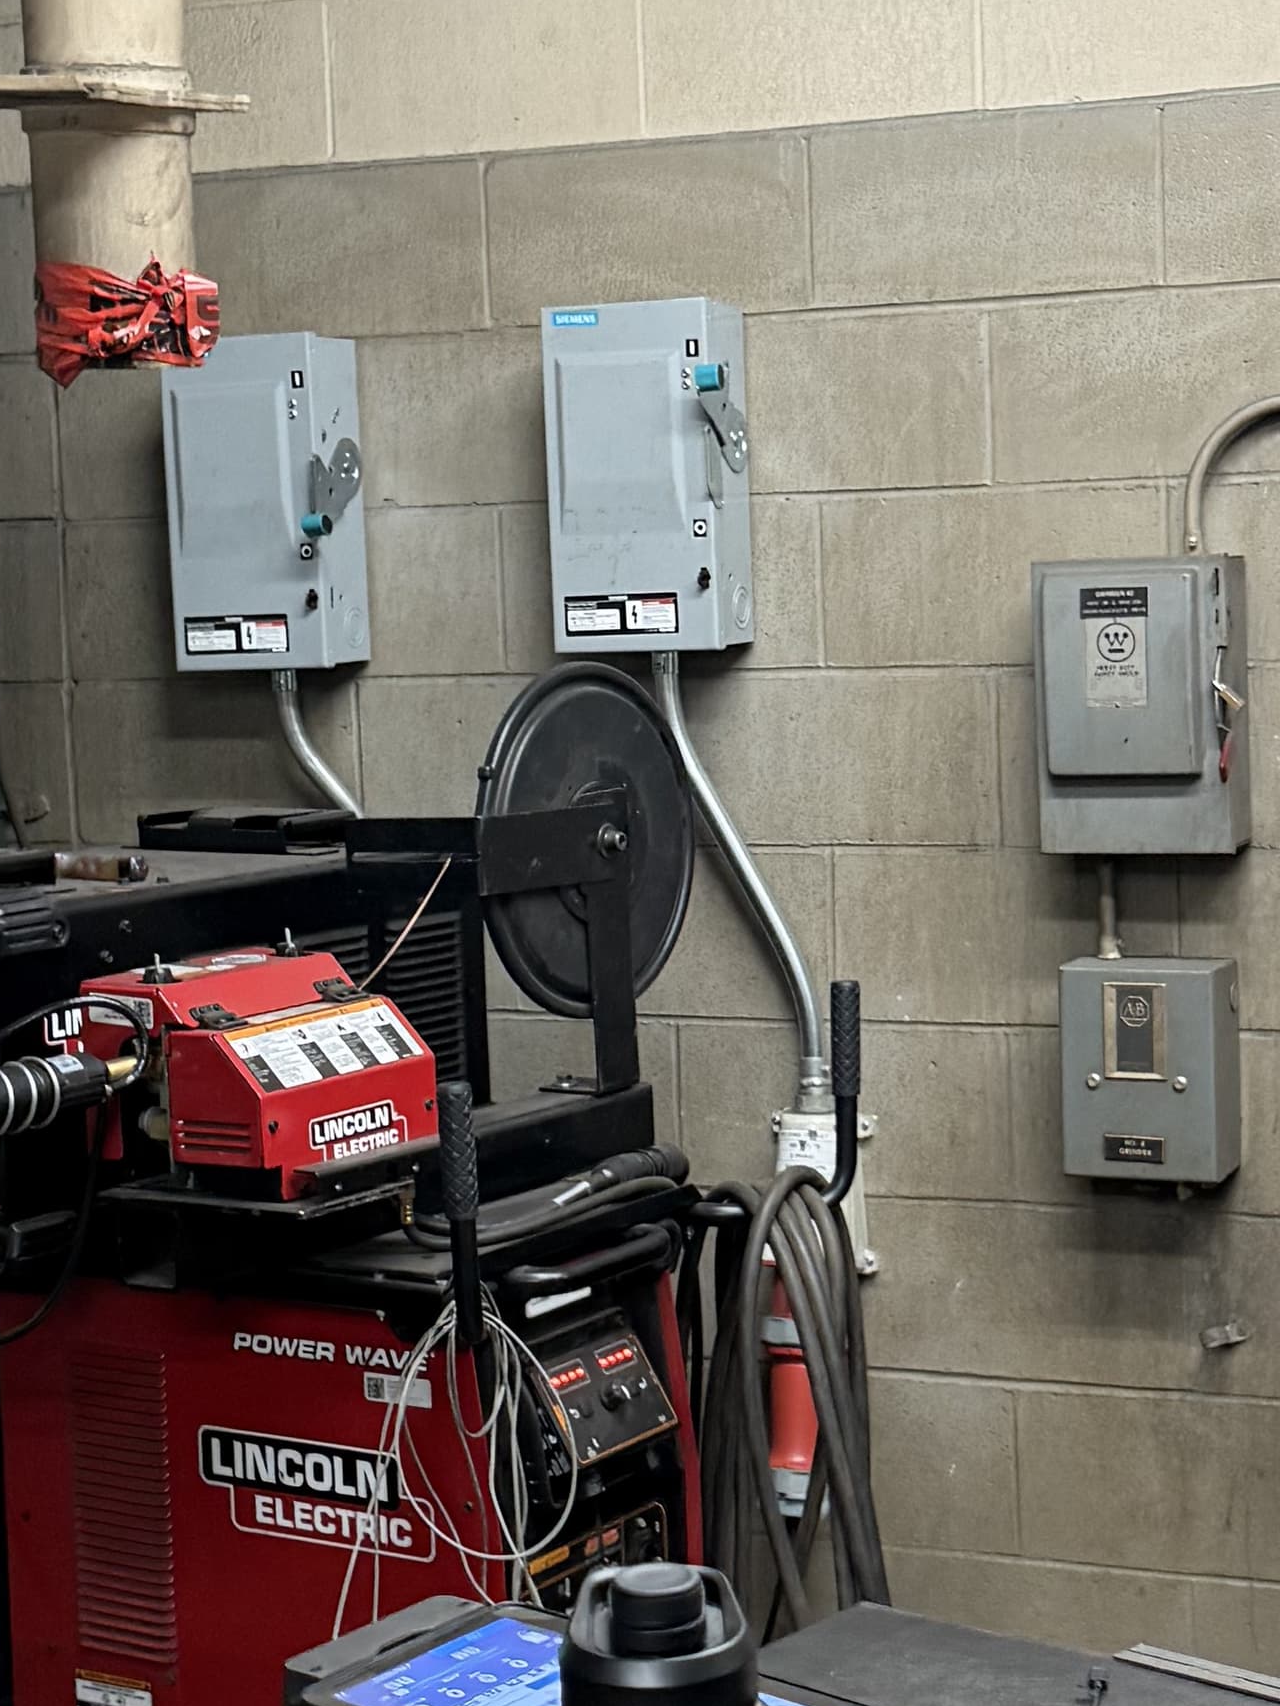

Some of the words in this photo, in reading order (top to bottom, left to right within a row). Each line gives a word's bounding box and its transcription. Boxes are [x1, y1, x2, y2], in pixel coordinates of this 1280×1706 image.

[314, 1105, 389, 1143] LINCOLN
[333, 1129, 399, 1160] ELECTRIC
[233, 1332, 335, 1362] POWER
[210, 1436, 390, 1502] LINCOLN
[254, 1493, 413, 1548] ELECTRIC
